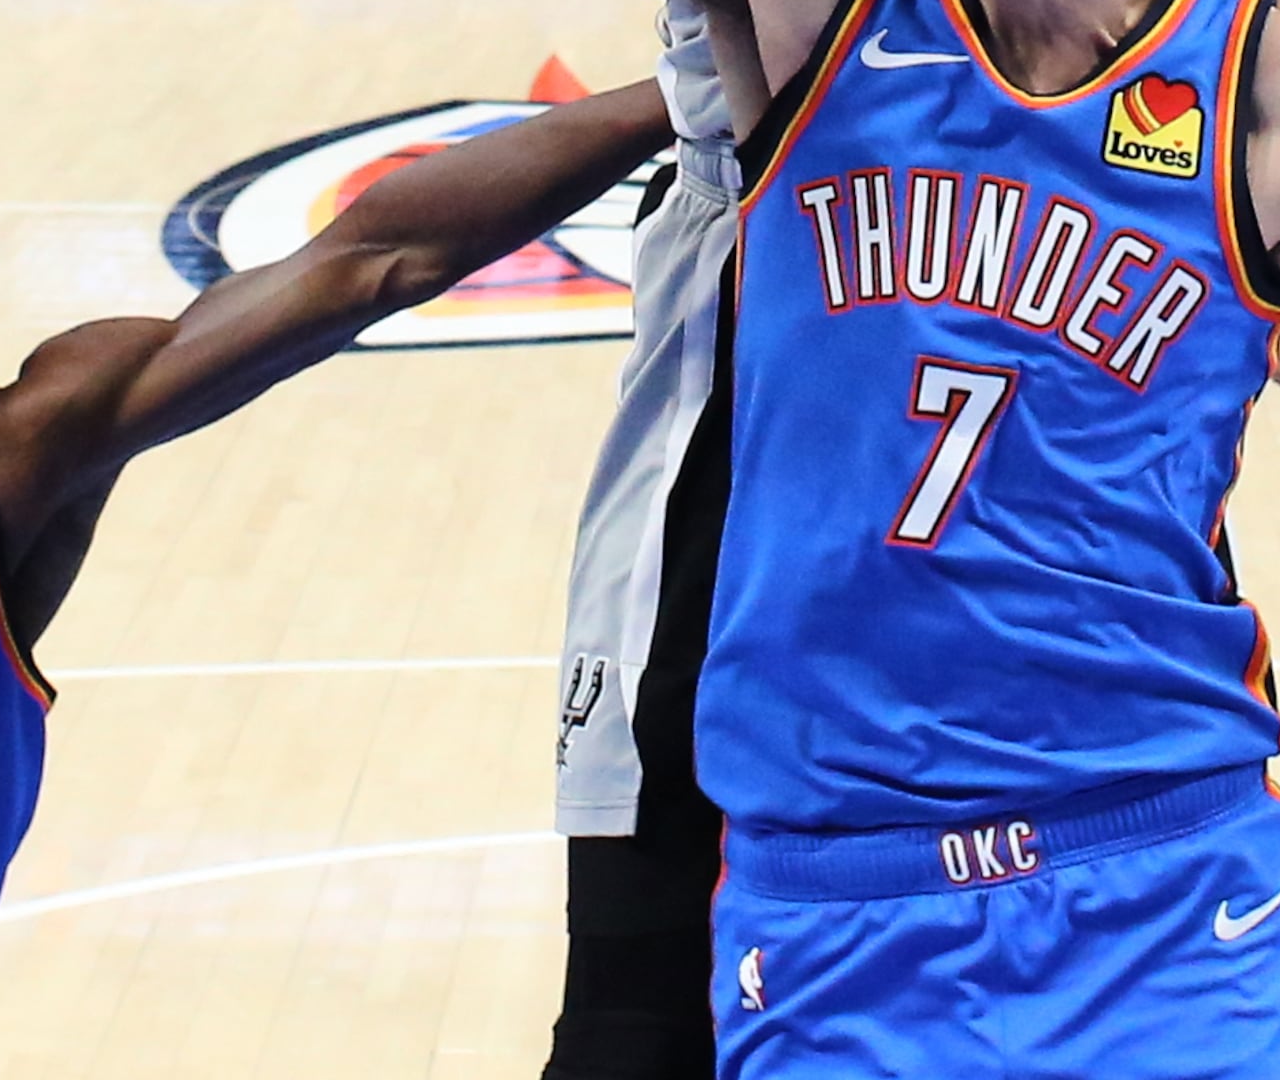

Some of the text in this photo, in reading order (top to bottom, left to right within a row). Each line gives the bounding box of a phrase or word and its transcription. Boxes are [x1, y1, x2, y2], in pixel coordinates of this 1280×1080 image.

[799, 169, 1208, 393] THUNDER
[887, 358, 1016, 546] 7
[939, 819, 1039, 885] OKC
